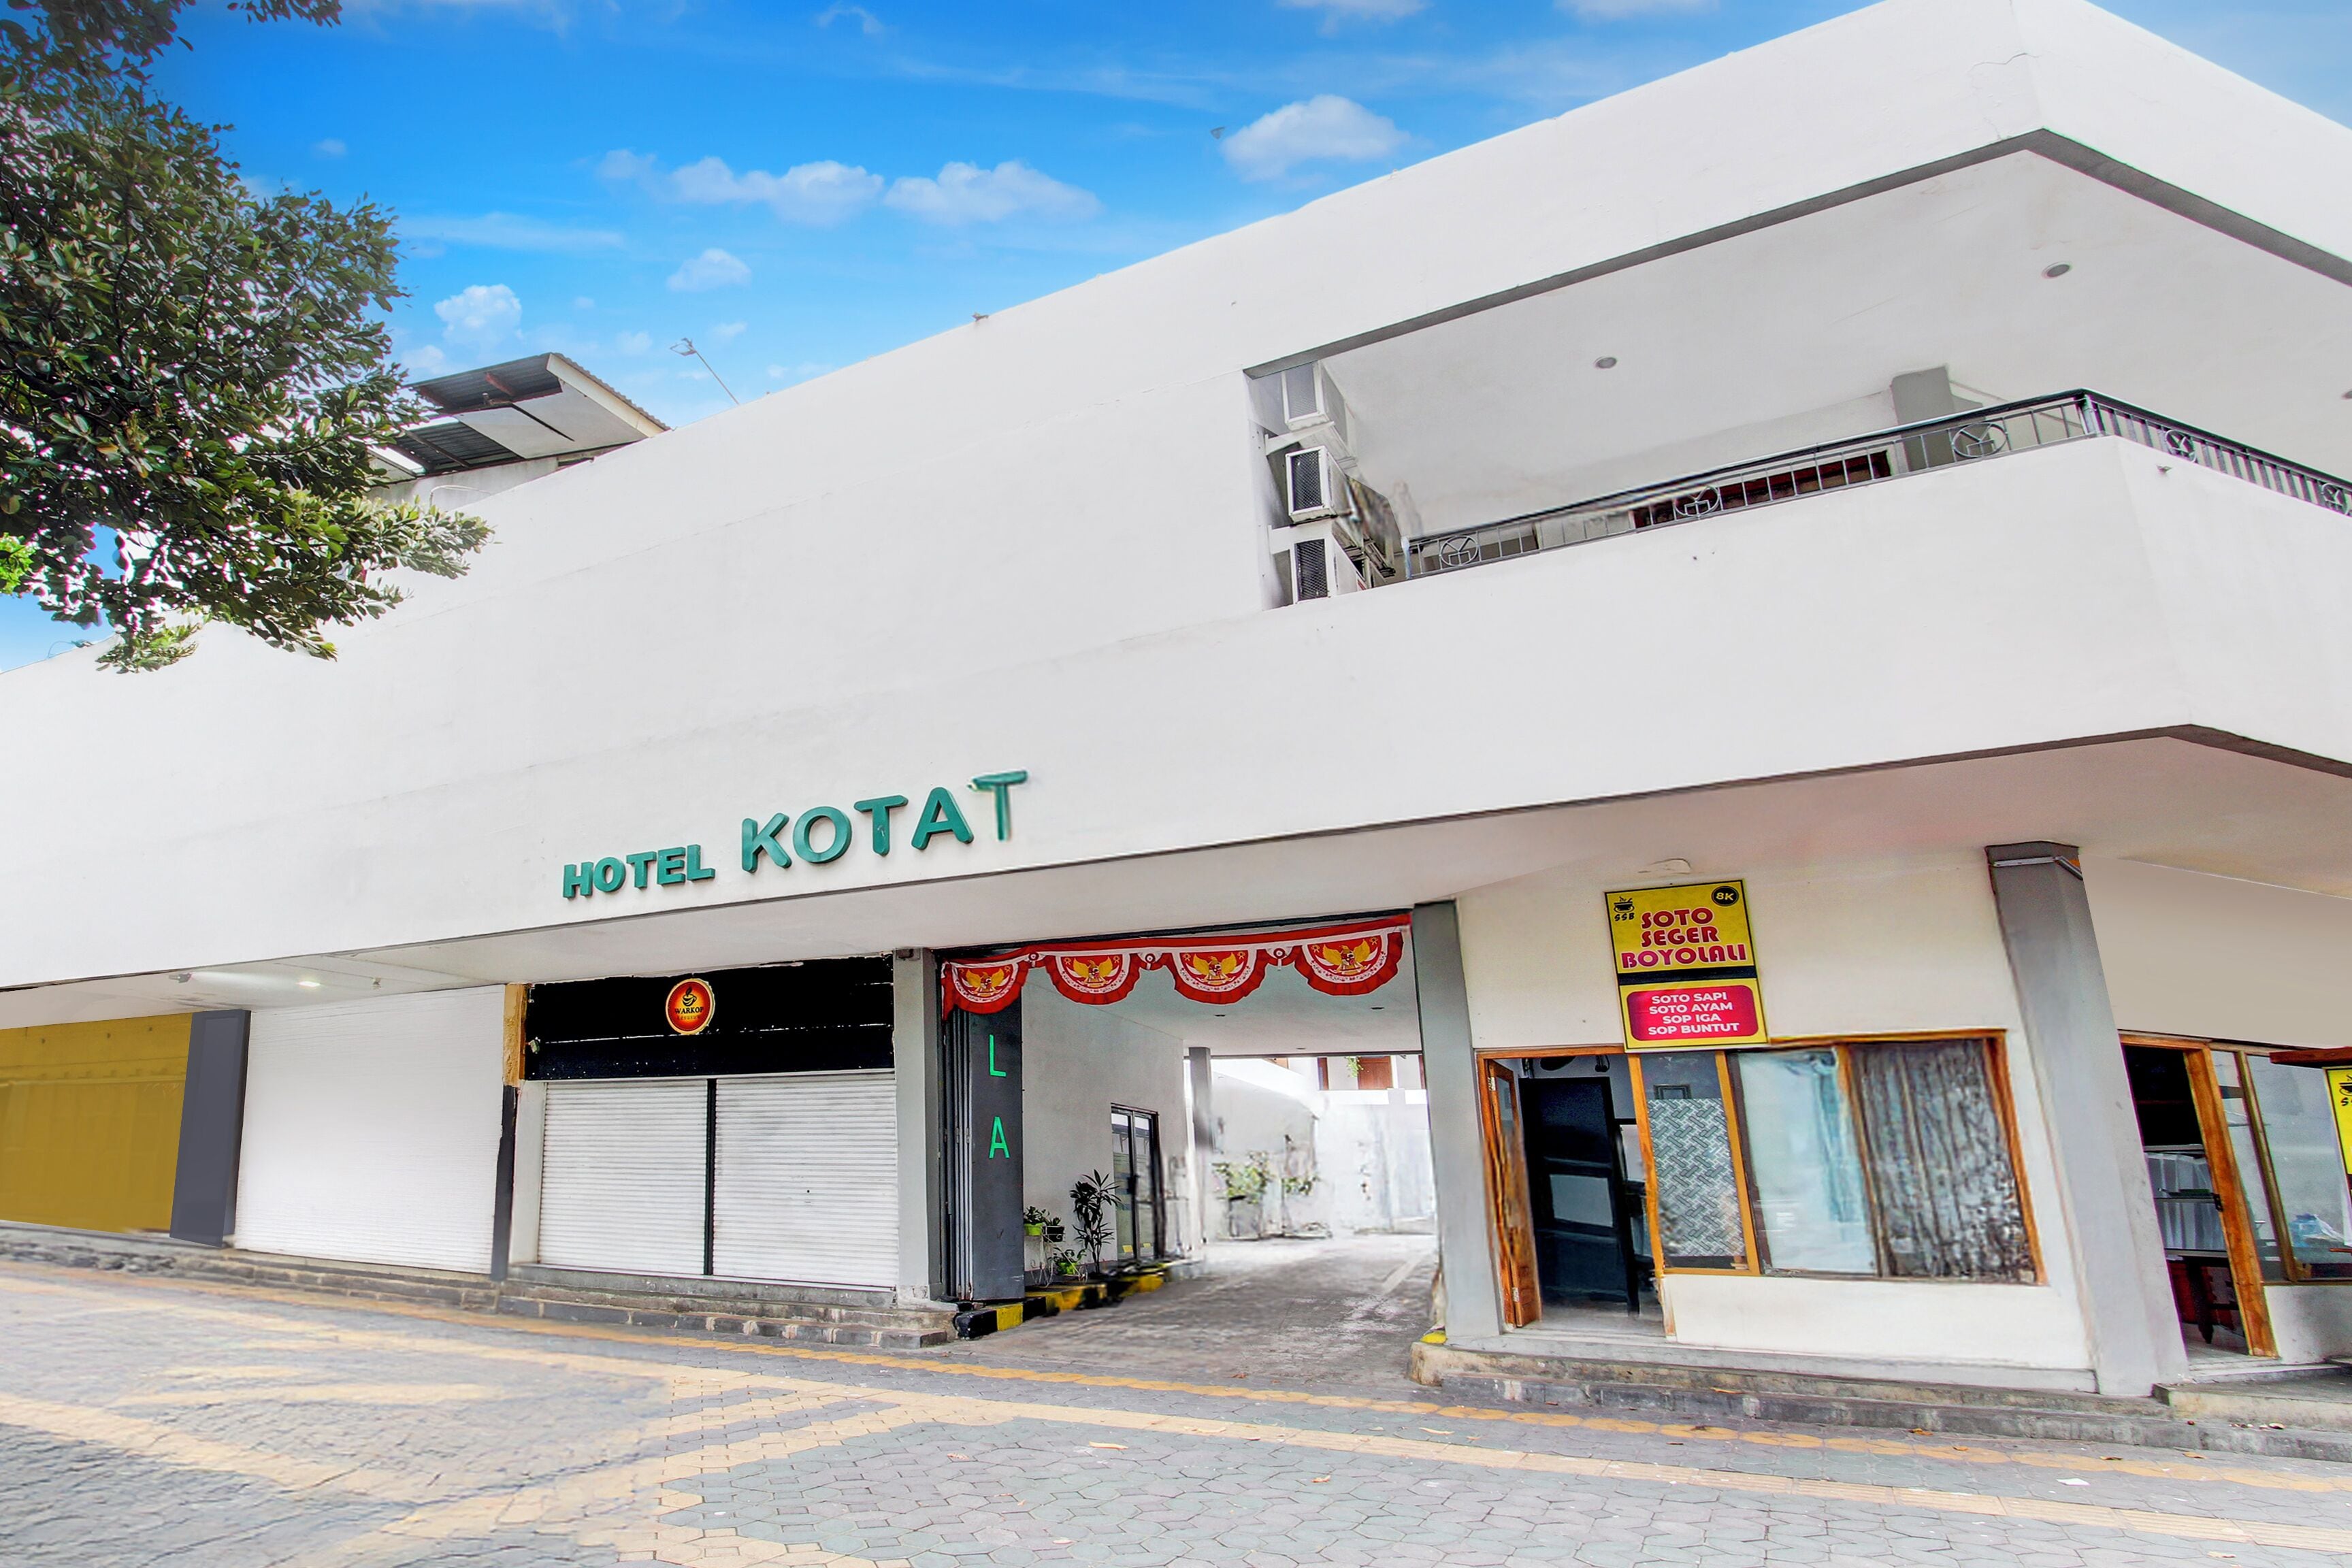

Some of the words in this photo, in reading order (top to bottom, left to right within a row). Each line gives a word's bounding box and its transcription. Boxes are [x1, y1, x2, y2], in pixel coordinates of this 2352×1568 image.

[563, 844, 715, 898] HOTEL
[741, 770, 1028, 874] KOTAT
[1614, 912, 1635, 921] SSB
[1641, 907, 1714, 929] SOTO
[1641, 926, 1720, 947] SEGER
[1621, 944, 1747, 968] BOYOLALI
[1652, 994, 1690, 1004] SOTO
[1693, 992, 1727, 1002] SAPI
[1649, 1004, 1688, 1015] SOTO
[1691, 1002, 1733, 1012] AYAM
[1663, 1014, 1692, 1024] SOP
[1696, 1013, 1721, 1022] IGA
[1648, 1025, 1677, 1035] SOP
[1681, 1023, 1740, 1034] BUNTUT
